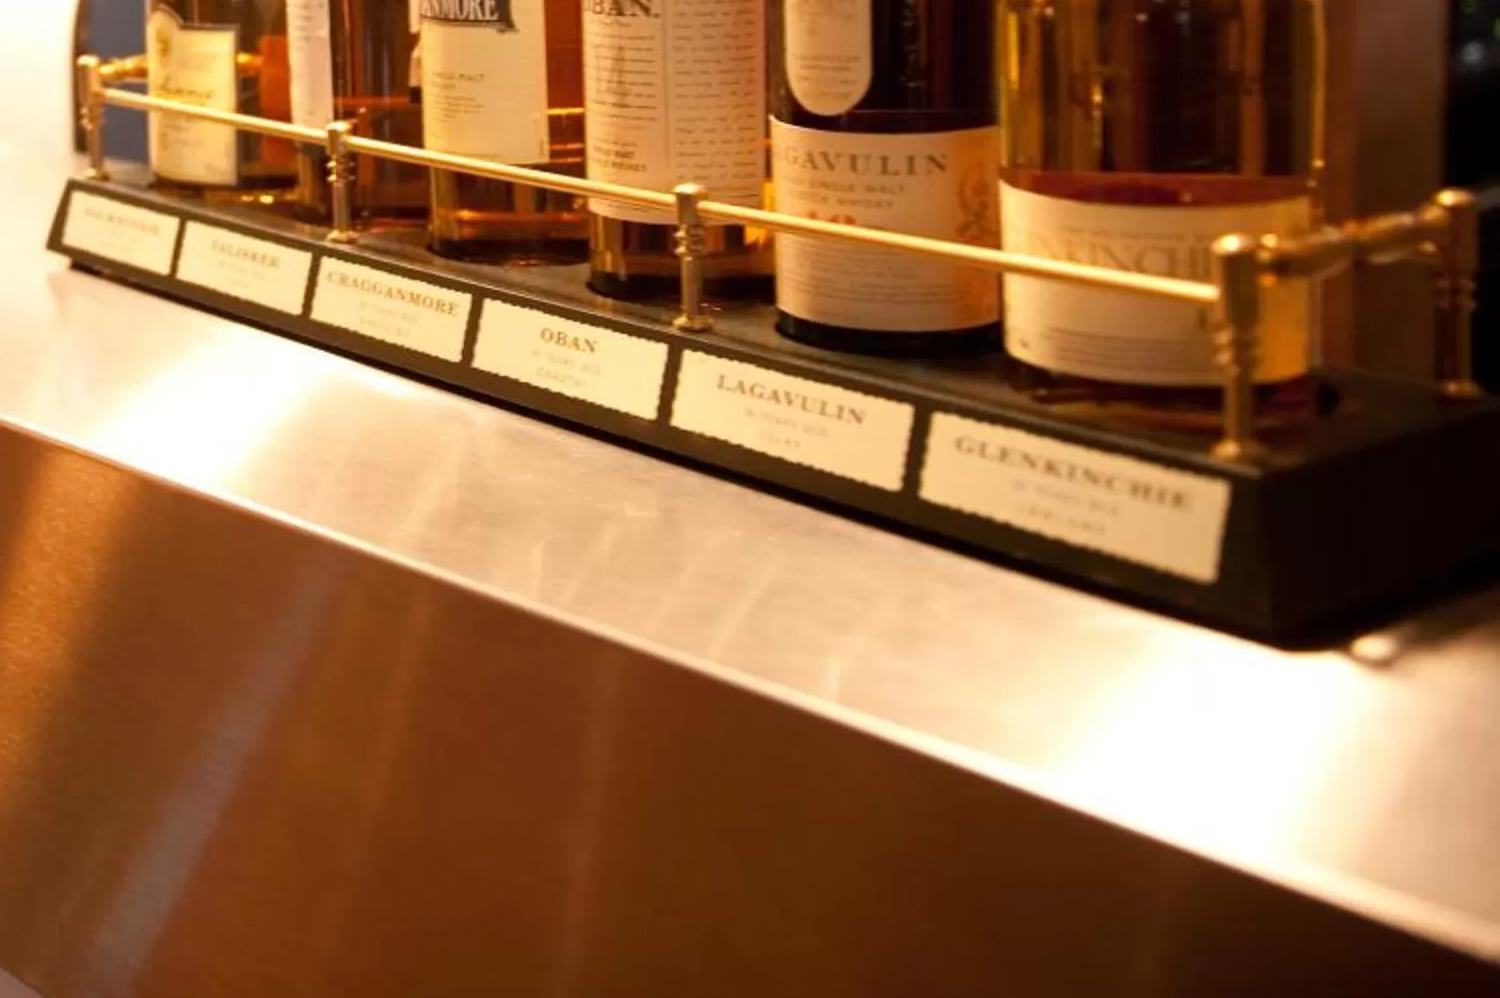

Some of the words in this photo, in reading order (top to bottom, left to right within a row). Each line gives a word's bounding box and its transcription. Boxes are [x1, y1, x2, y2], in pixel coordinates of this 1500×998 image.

[327, 271, 460, 317] CRAGGANMORE
[540, 327, 598, 354] OBAN
[717, 373, 866, 425] LAGAVULIN
[954, 435, 1193, 512] GLENKINCHIE
